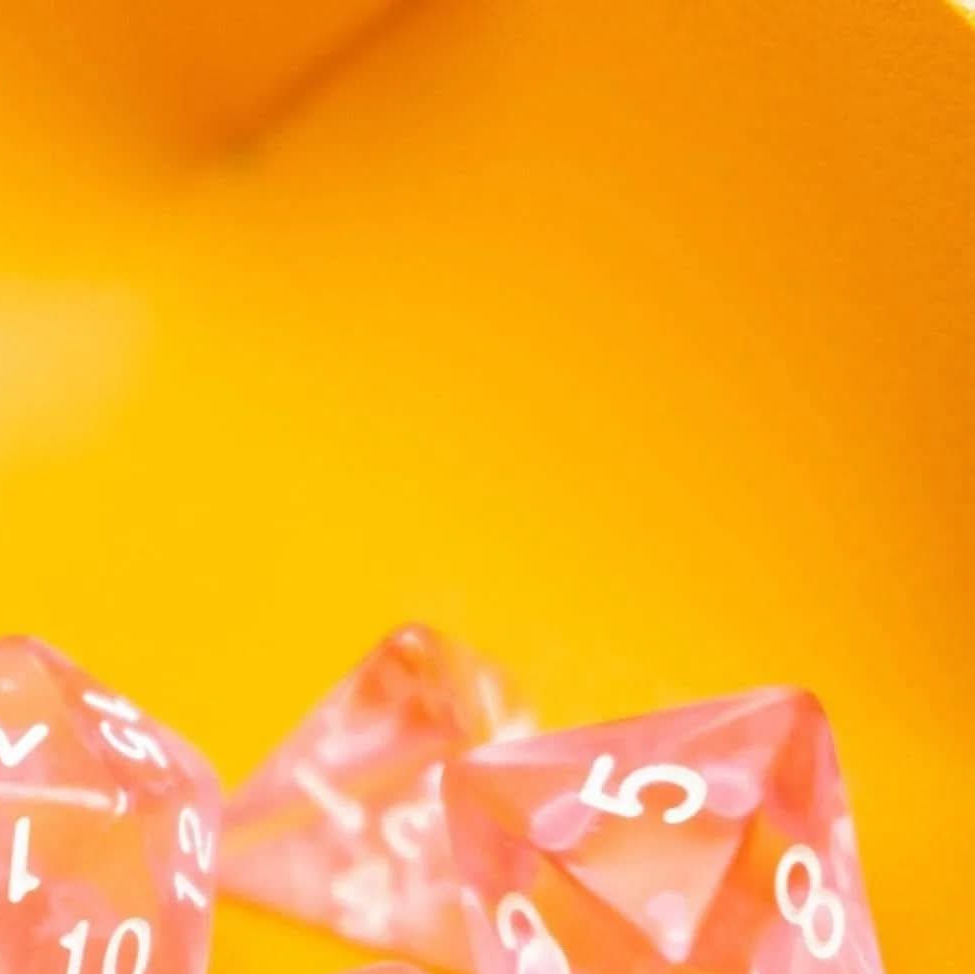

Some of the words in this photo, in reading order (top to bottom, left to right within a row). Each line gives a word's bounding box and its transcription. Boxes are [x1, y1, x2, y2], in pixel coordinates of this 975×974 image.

[82, 690, 168, 768] 15
[581, 754, 707, 824] 5
[174, 807, 214, 908] 12
[774, 844, 844, 960] 8
